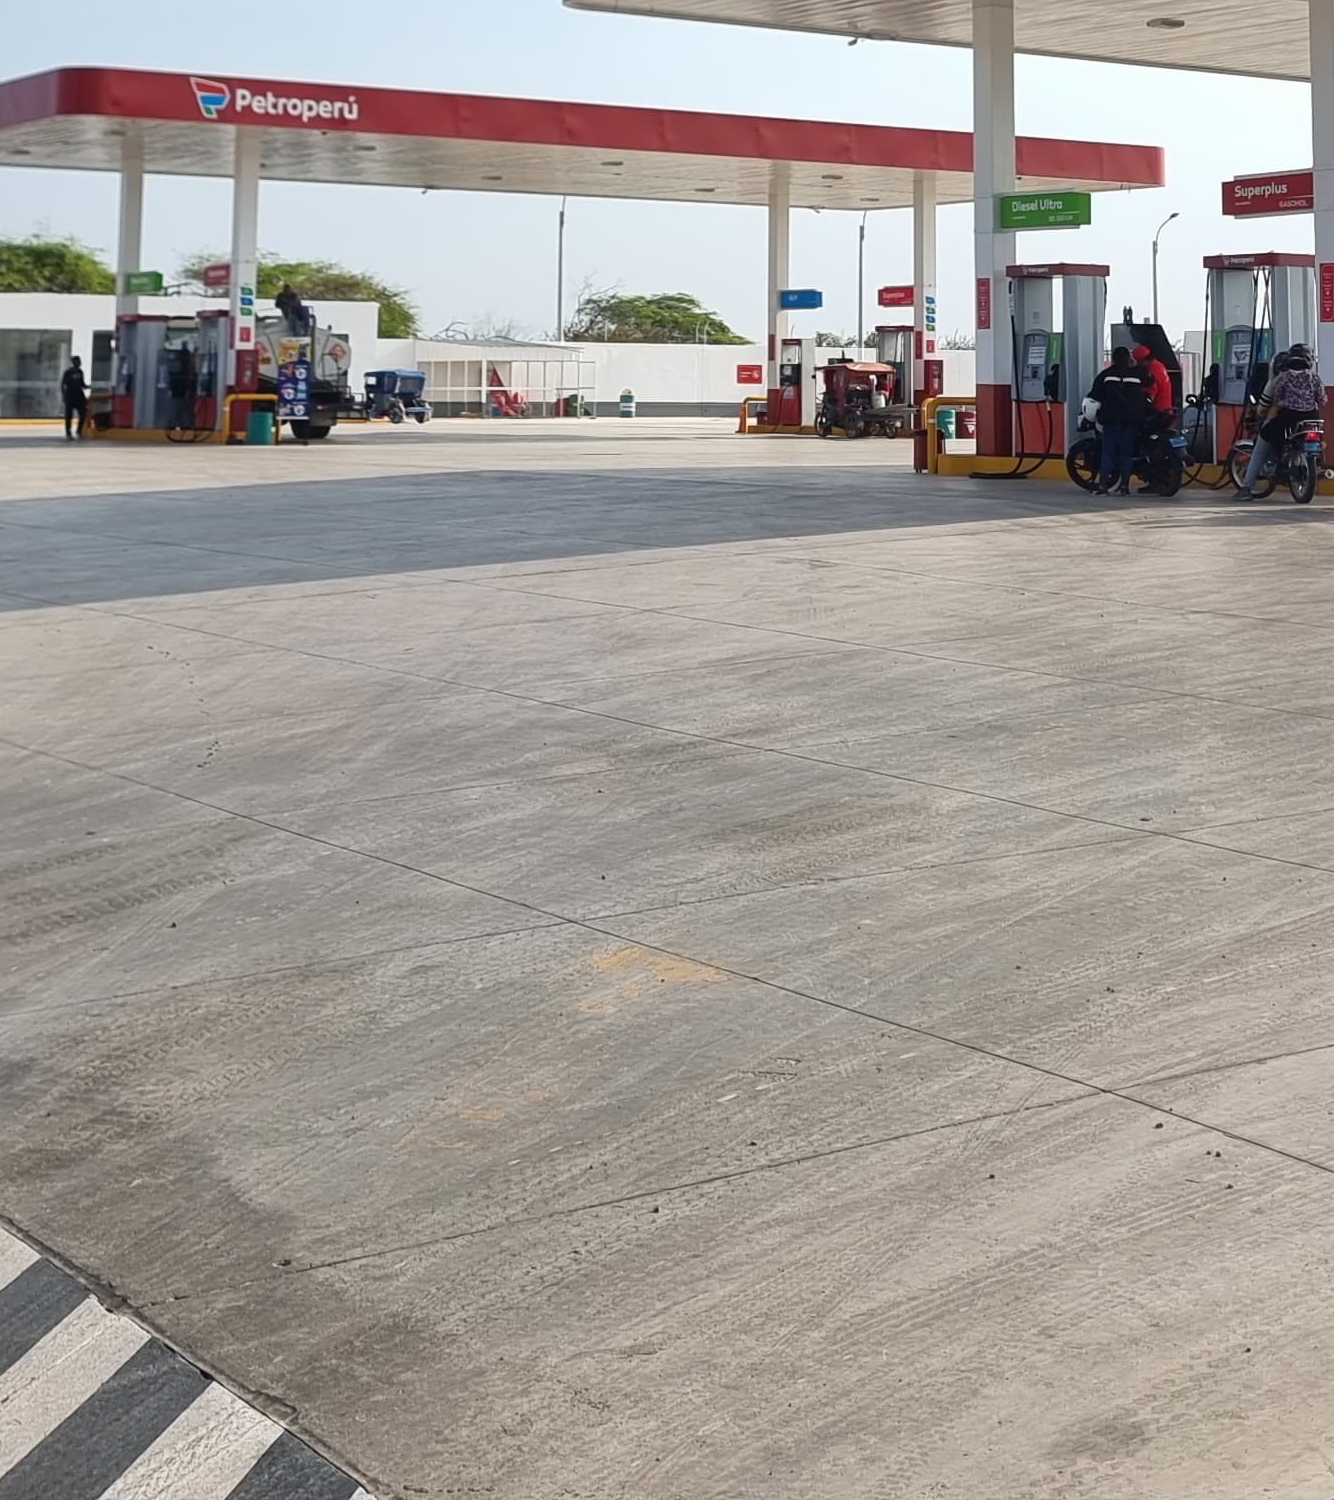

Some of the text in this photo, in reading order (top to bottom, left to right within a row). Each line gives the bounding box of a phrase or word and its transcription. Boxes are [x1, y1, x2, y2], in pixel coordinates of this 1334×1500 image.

[235, 88, 358, 123] Petroperú
[1234, 182, 1288, 200] Superplus
[1011, 199, 1063, 212] Diesel Ultra
